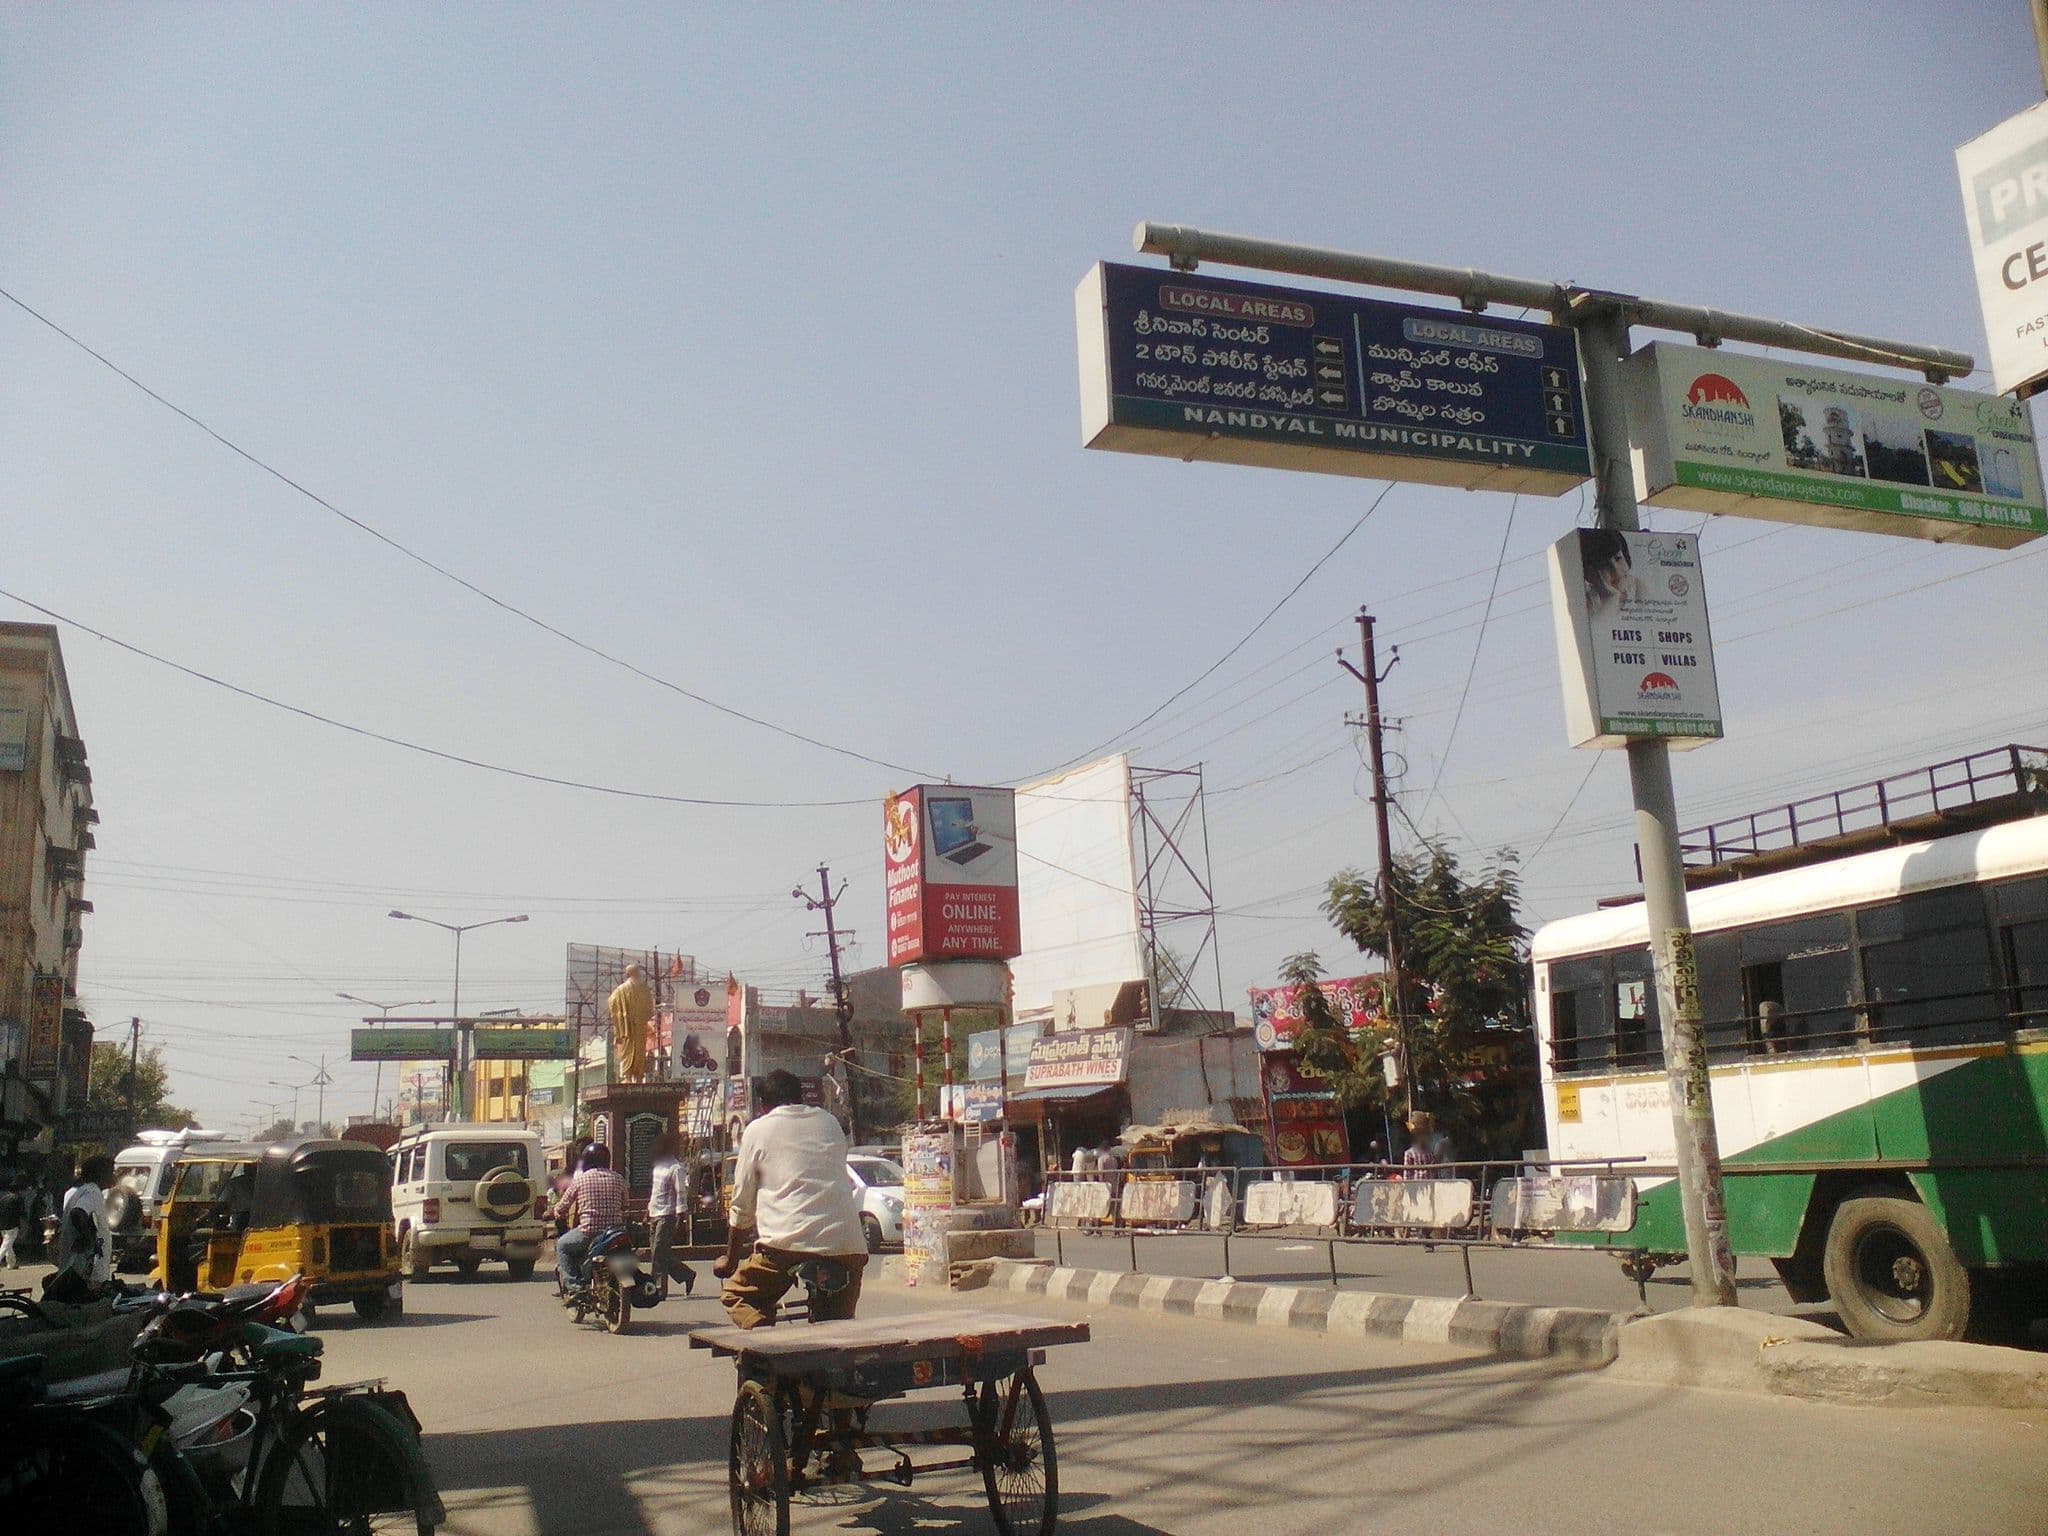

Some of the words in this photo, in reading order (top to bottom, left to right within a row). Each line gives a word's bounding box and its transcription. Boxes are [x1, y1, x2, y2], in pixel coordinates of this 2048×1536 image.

[1168, 291, 1235, 313] LOCAL
[1241, 300, 1306, 322] AREAS
[1133, 309, 1207, 335] శ్రీనివాస్
[1211, 322, 1270, 345] సెంటర్
[1412, 324, 1473, 343] LOCAL
[1478, 332, 1537, 353] AREAS
[1135, 343, 1149, 360] 2
[1202, 349, 1259, 372] పోలీస్
[1262, 354, 1308, 381] స్టేషన్
[1368, 343, 1451, 369] మున్సిపల్
[1454, 351, 1499, 374] ఆఫీస్
[1136, 371, 1211, 396] గవర్నమెంట్
[1212, 380, 1256, 399] జనరల్
[1370, 369, 1422, 393] శ్యామ్
[1425, 377, 1483, 397] కాలువ
[1372, 395, 1437, 421] బొమ్మల
[1440, 403, 1486, 426] సత్రం
[1682, 403, 1755, 428] SKANDHANSHI
[1183, 406, 1324, 436] NANDYAL
[1335, 422, 1536, 458] MUNICIPALITY
[1611, 629, 1643, 642] FLATS
[1658, 631, 1693, 644] SHOPS
[1613, 652, 1646, 665] PLOTS
[1661, 654, 1697, 667] VILLAS
[945, 892, 960, 901] PAY
[962, 893, 997, 903] INTEREST
[942, 903, 1001, 921] ONLINE.
[942, 936, 970, 949] ANY
[971, 937, 1003, 950] TIME.
[1028, 1062, 1085, 1080] SUPRABATH
[1085, 1060, 1119, 1076] WINES
